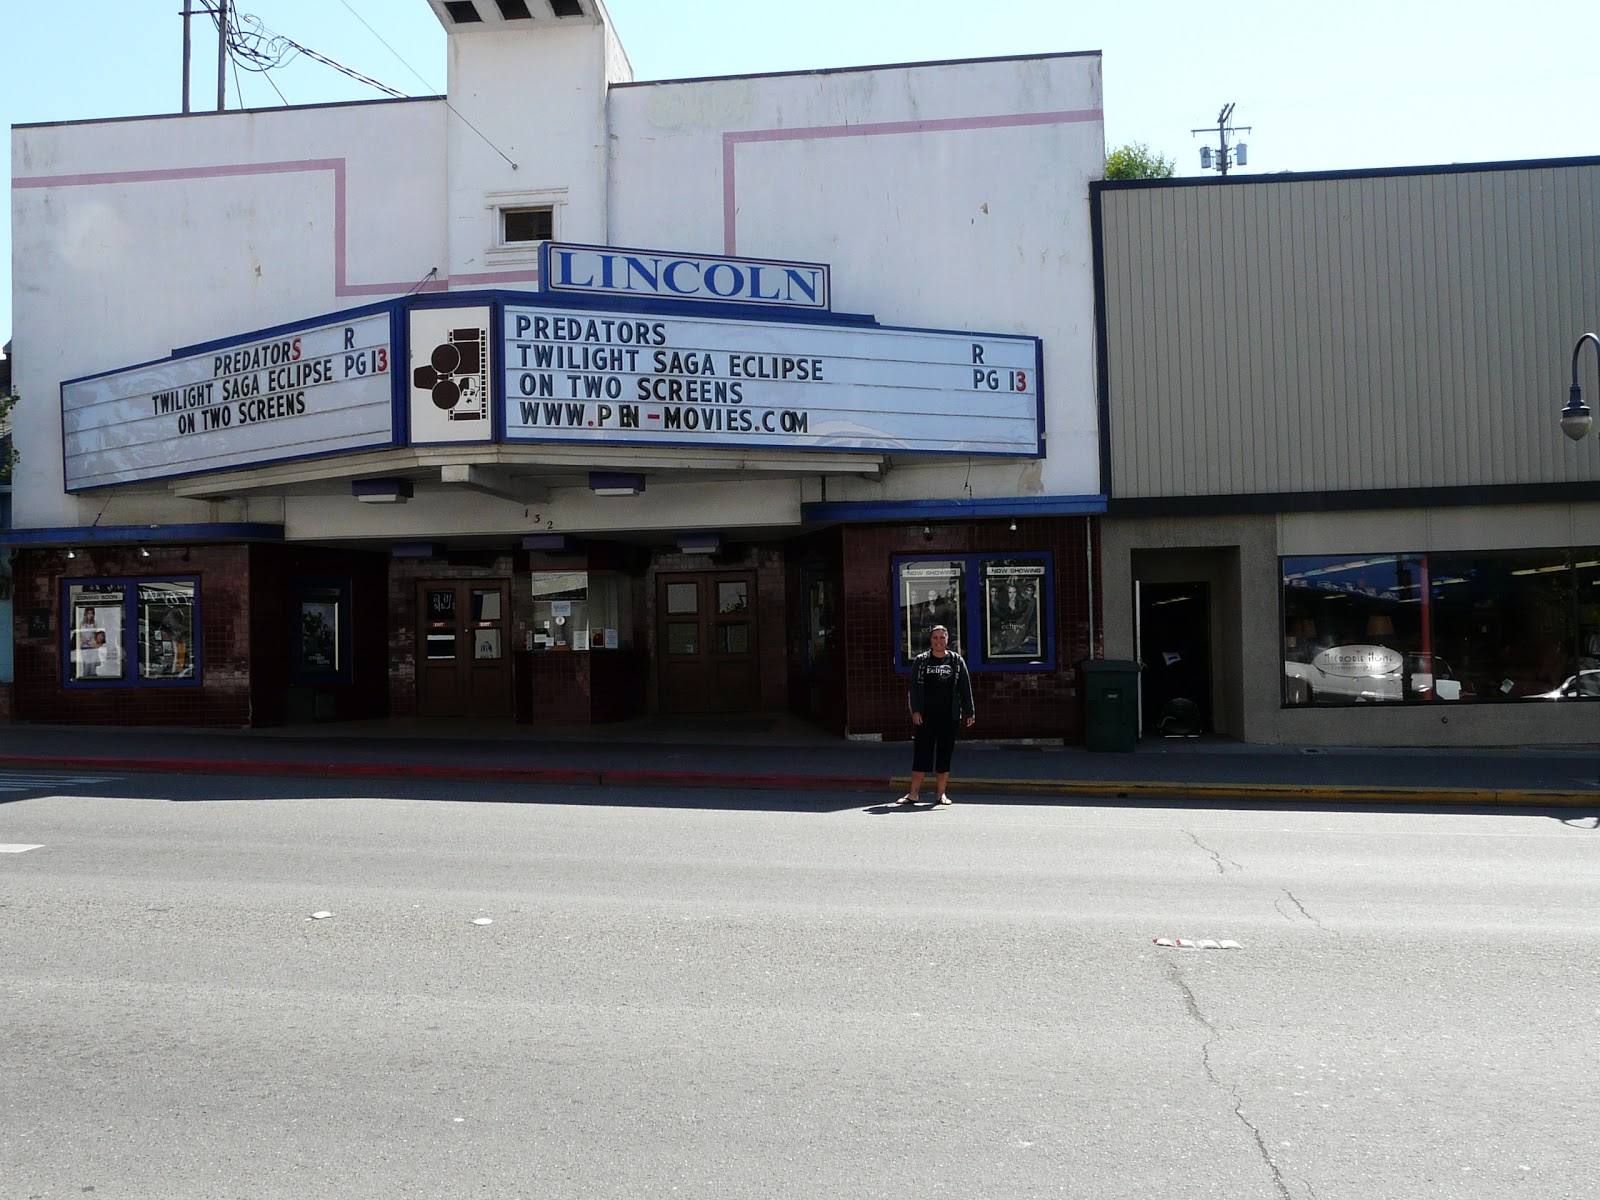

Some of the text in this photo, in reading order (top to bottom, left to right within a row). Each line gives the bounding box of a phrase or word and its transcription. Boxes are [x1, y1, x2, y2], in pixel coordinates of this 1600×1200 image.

[555, 251, 820, 303] LINCOLN
[214, 327, 354, 377] PREDATORS R
[515, 314, 985, 364] PREDATORS R
[152, 348, 388, 416] TWILIGHT SAGA ECLIPSE PG 13
[516, 344, 1027, 392] TWILIGHT SAGA ECLIPSE PG 13
[519, 372, 743, 405] ON TWO SCREENS
[178, 391, 306, 435] ON TWO SCREENS
[525, 508, 553, 530] 132
